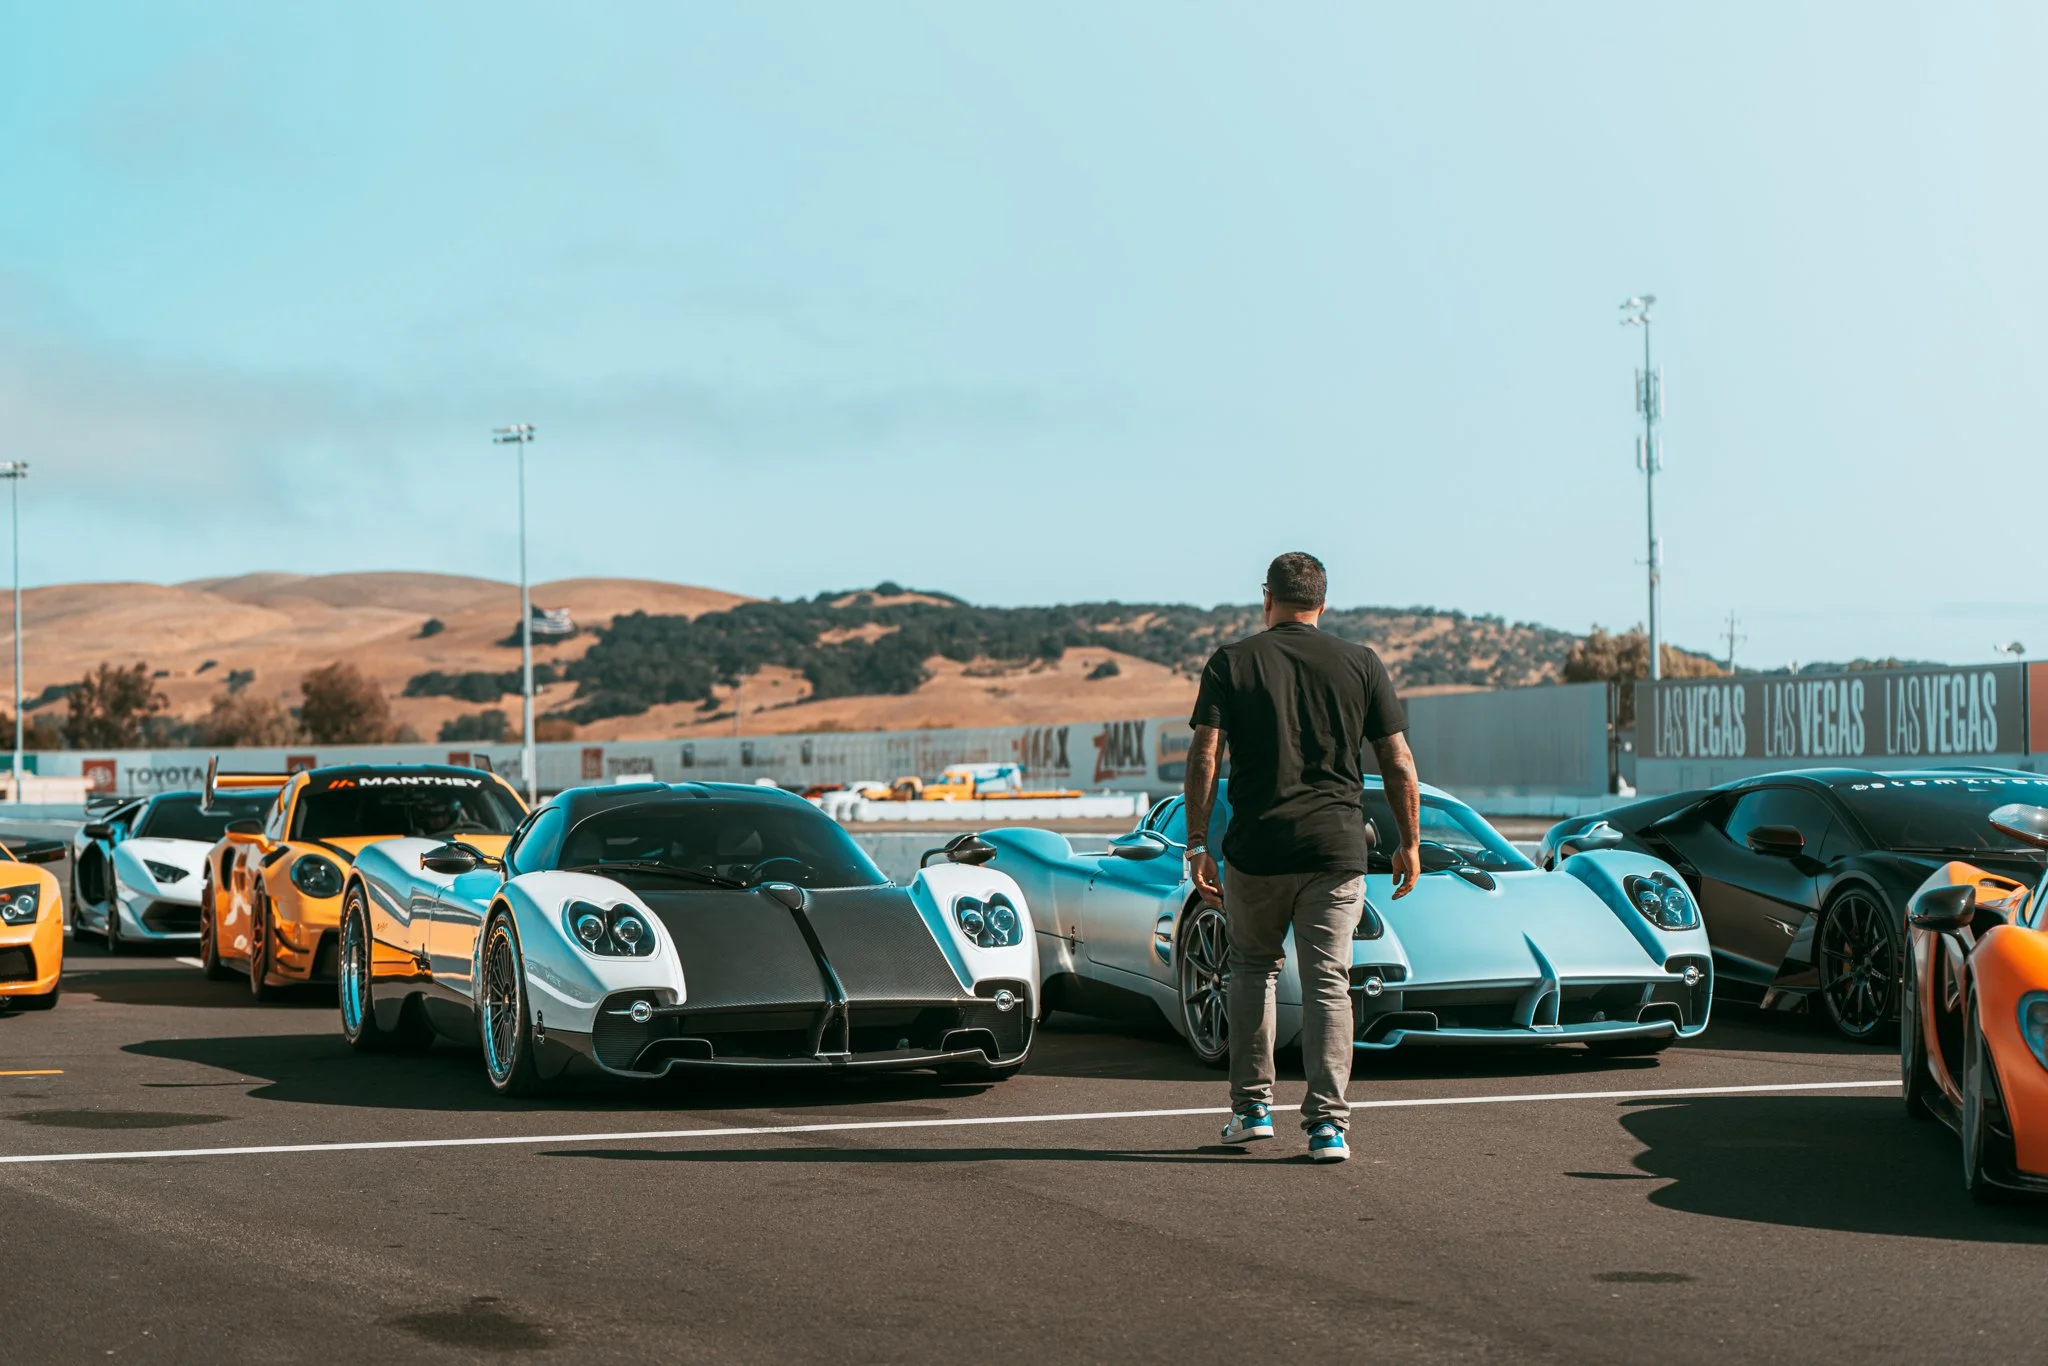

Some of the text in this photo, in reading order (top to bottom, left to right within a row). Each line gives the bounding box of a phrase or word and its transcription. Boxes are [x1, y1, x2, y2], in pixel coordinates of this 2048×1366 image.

[1655, 684, 1746, 757] LAS VEGAS
[1763, 679, 1865, 757] LAS VEGAS
[1885, 671, 1998, 755] LAS VEGAS
[125, 766, 204, 787] TOYOTA
[359, 777, 482, 788] MANTHEY
